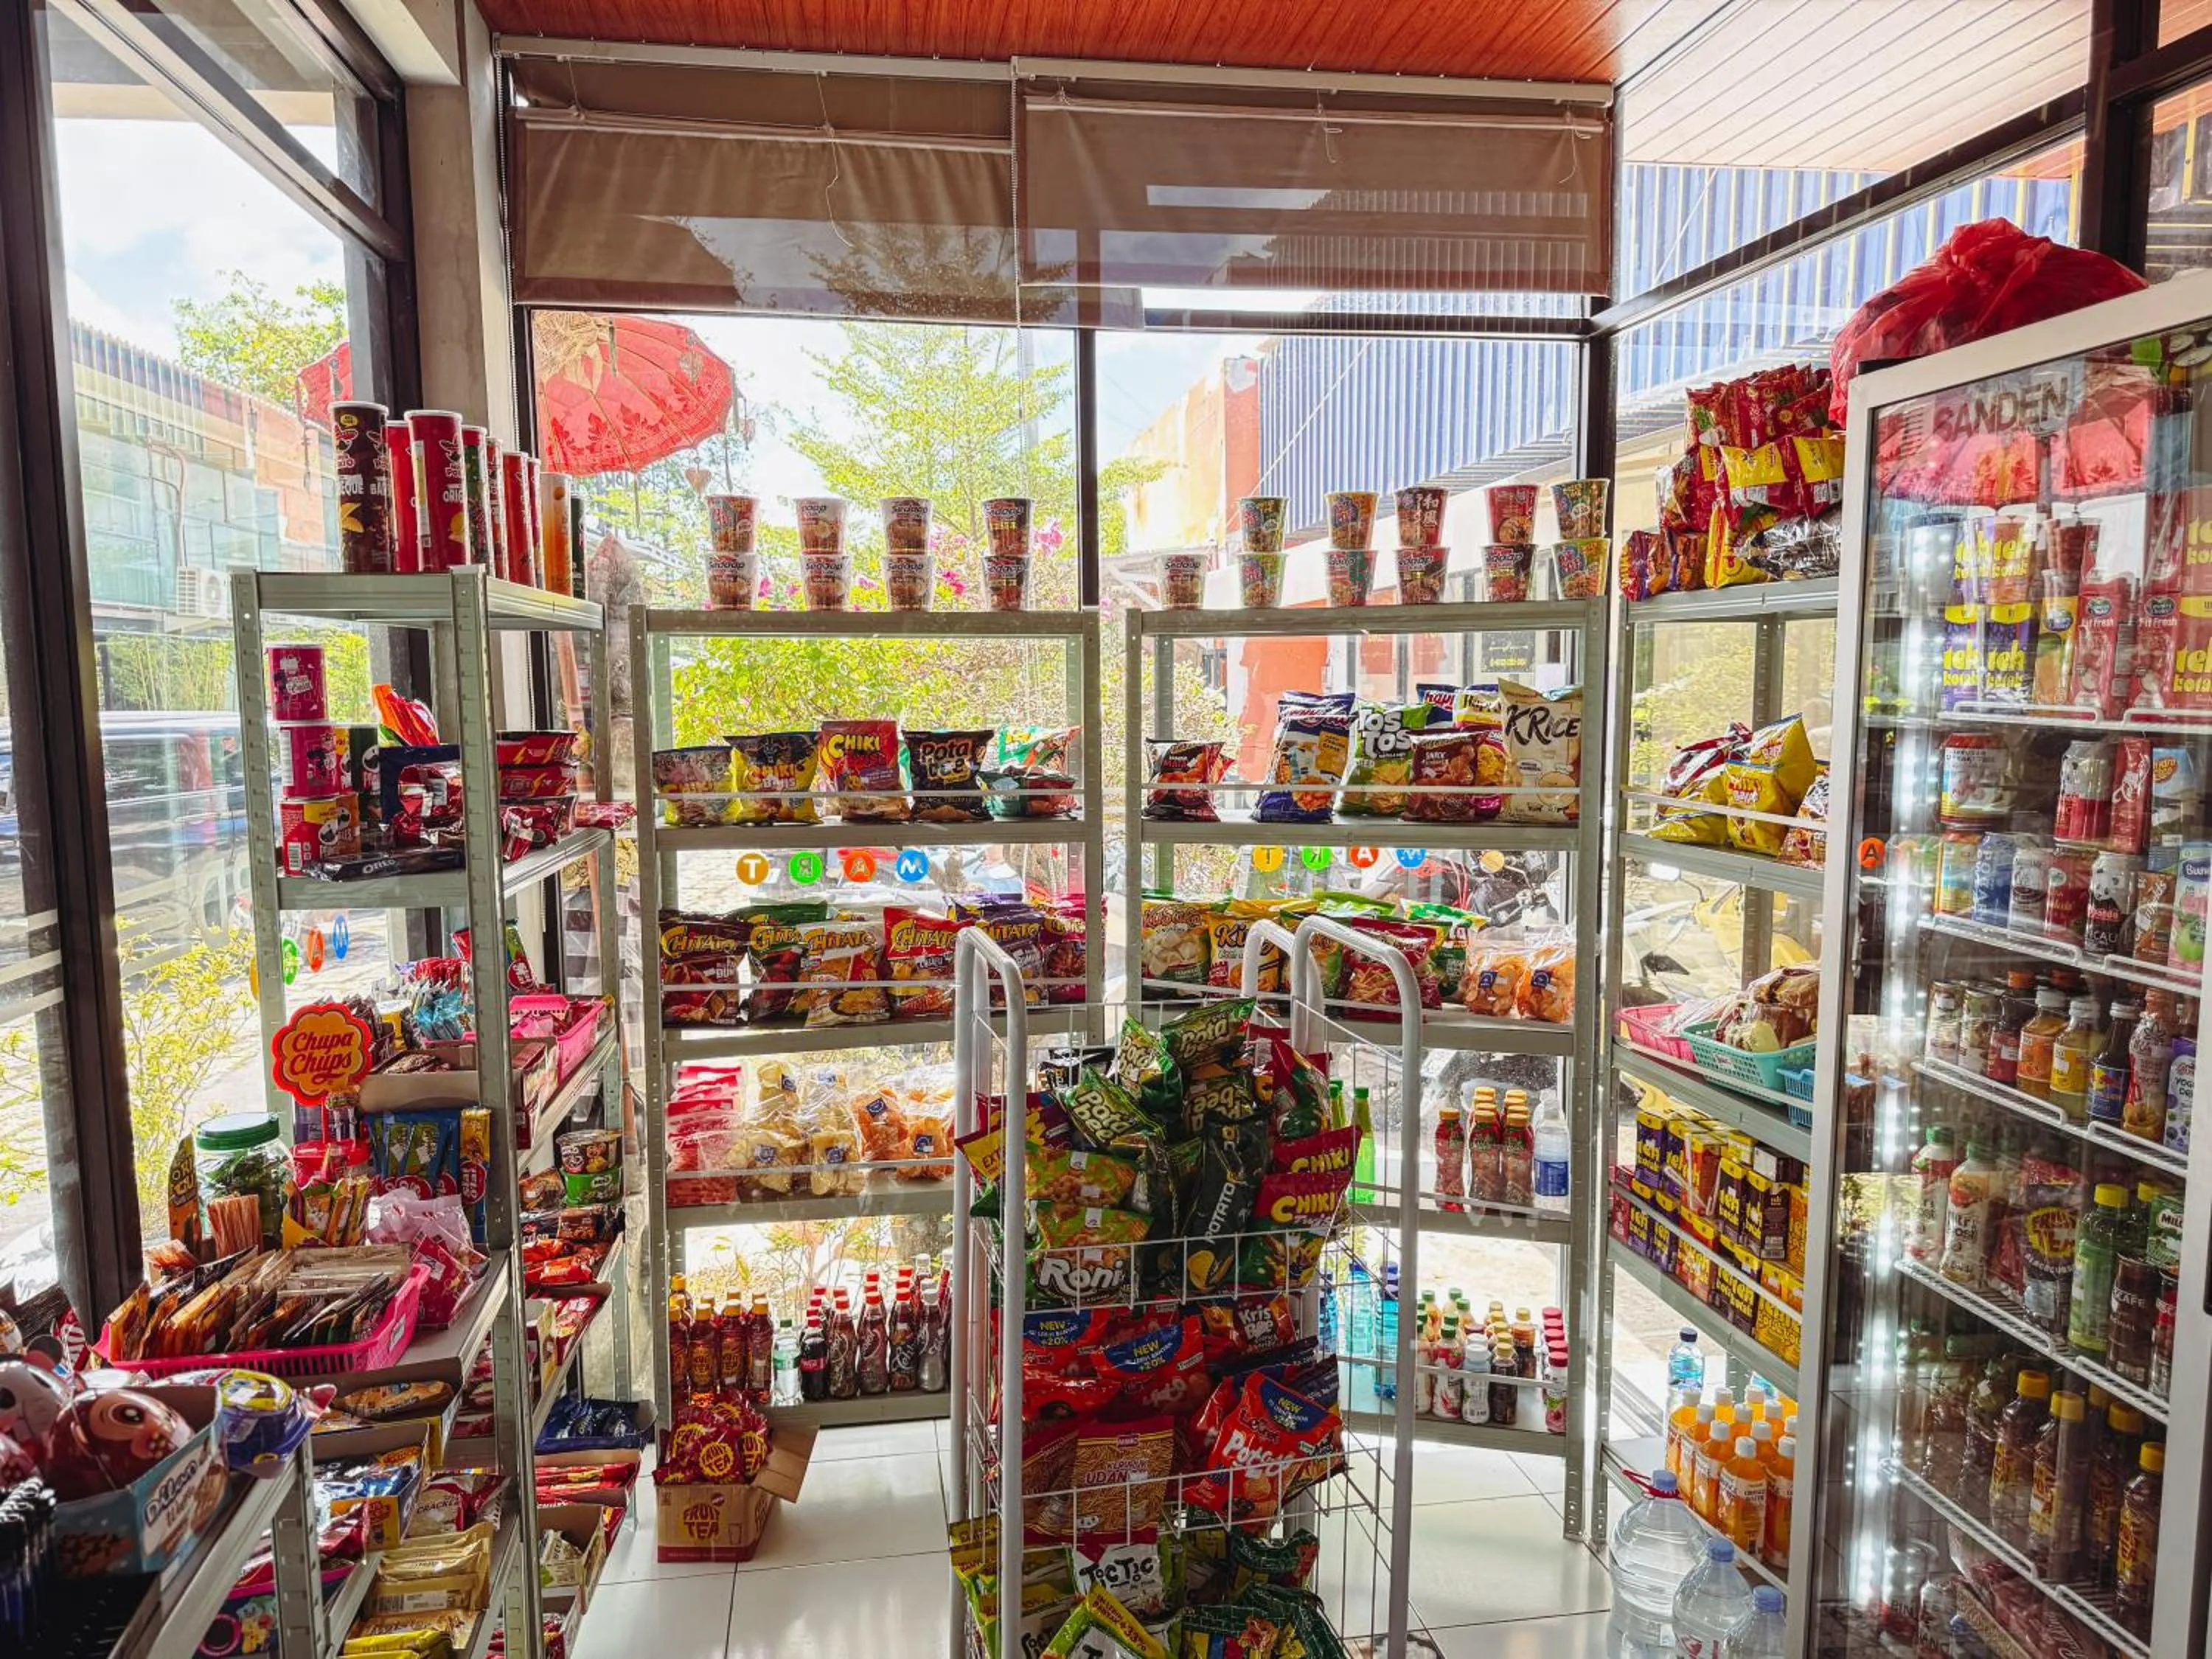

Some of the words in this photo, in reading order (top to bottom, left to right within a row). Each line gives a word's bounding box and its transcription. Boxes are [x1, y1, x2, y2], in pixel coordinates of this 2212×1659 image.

[1932, 378, 2069, 441] SANDEN
[1986, 639, 2025, 671] teh
[826, 733, 881, 759] CHIKI
[362, 858, 397, 874] OREO
[661, 925, 736, 959] CHITATO
[803, 927, 878, 956] CHITATO
[974, 920, 1040, 941] HITATO
[291, 1032, 355, 1050] Chupa
[288, 1049, 353, 1075] Chups
[1076, 1089, 1133, 1135] Pota
[1072, 1105, 1115, 1143] bee
[1205, 1181, 1237, 1245] POTATO
[1270, 1193, 1336, 1223] CHIKI
[1039, 1256, 1123, 1292] Roni
[1040, 1321, 1066, 1331] NEW
[1238, 1306, 1272, 1325] Kris
[1133, 1340, 1161, 1357] NEW
[1277, 1397, 1304, 1413] NEW
[701, 1441, 732, 1464] FRUIT
[706, 1455, 734, 1473] TEA
[1085, 1470, 1148, 1484] UDAN
[683, 1502, 720, 1522] FRUIT
[684, 1520, 720, 1540] TEA
